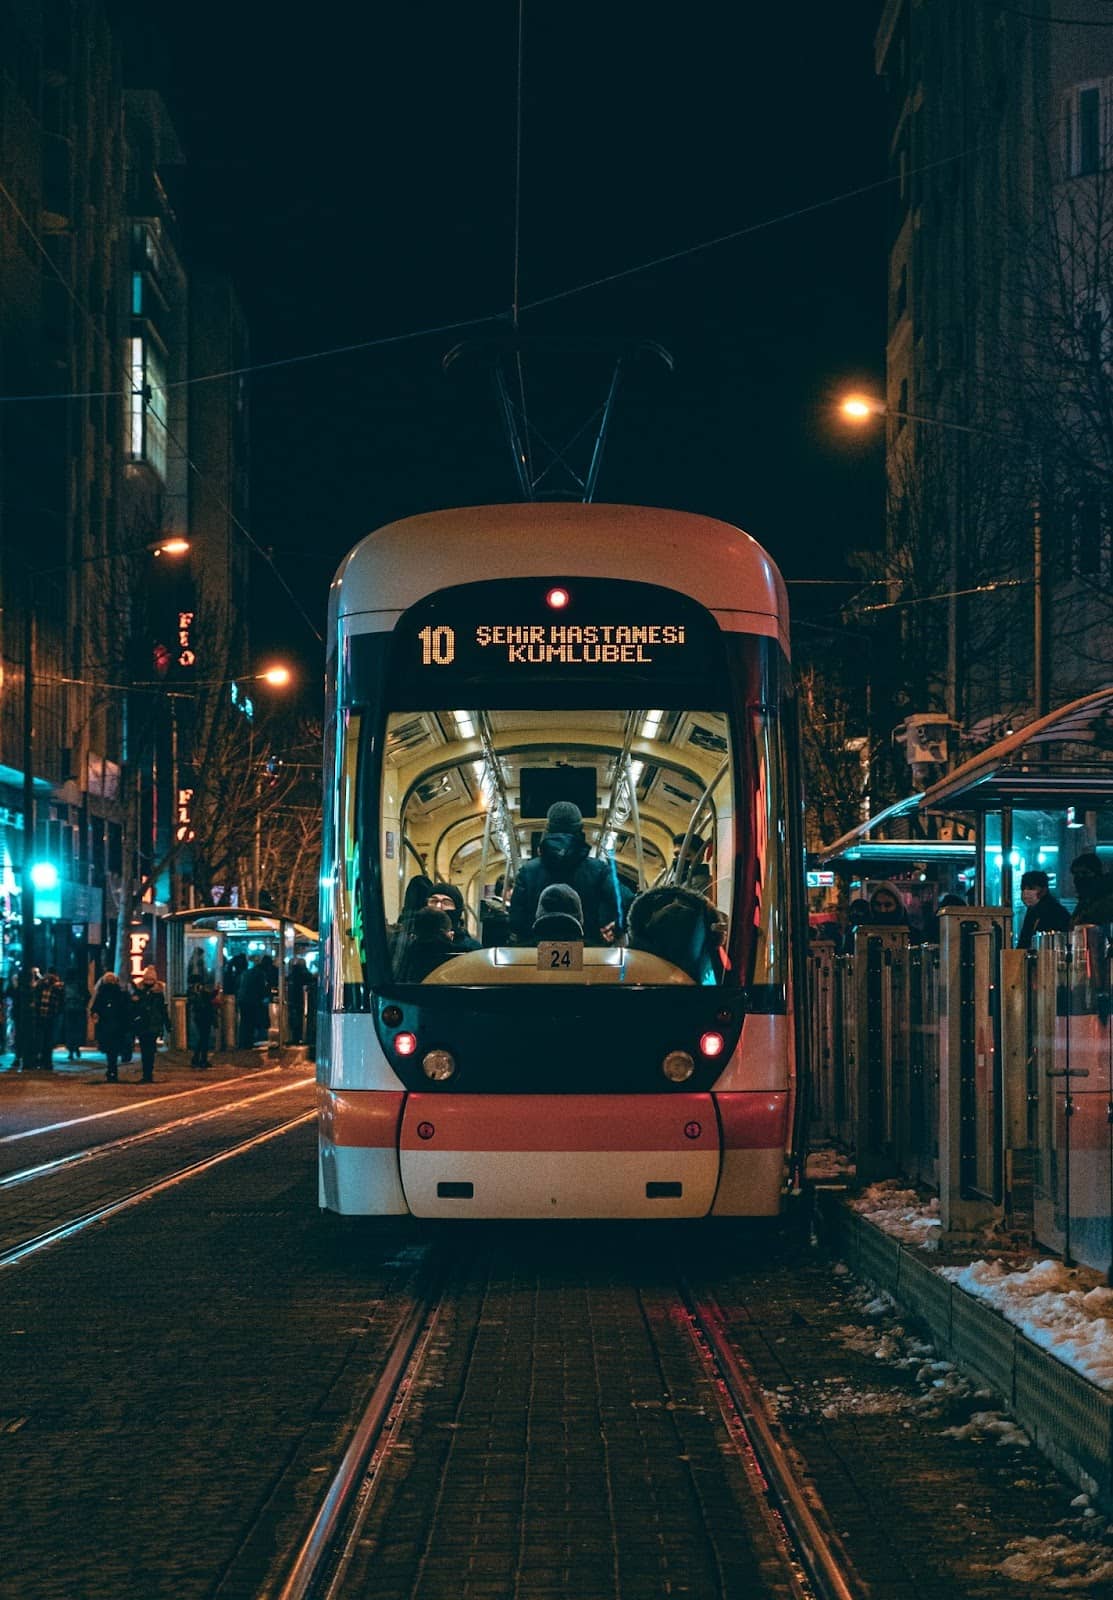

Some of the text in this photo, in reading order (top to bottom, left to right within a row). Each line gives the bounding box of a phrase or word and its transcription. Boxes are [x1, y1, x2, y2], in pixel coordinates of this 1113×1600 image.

[418, 626, 455, 665] 10
[508, 644, 653, 663] KUMLUBEL
[130, 932, 150, 984] FL
[551, 950, 571, 968] 24
